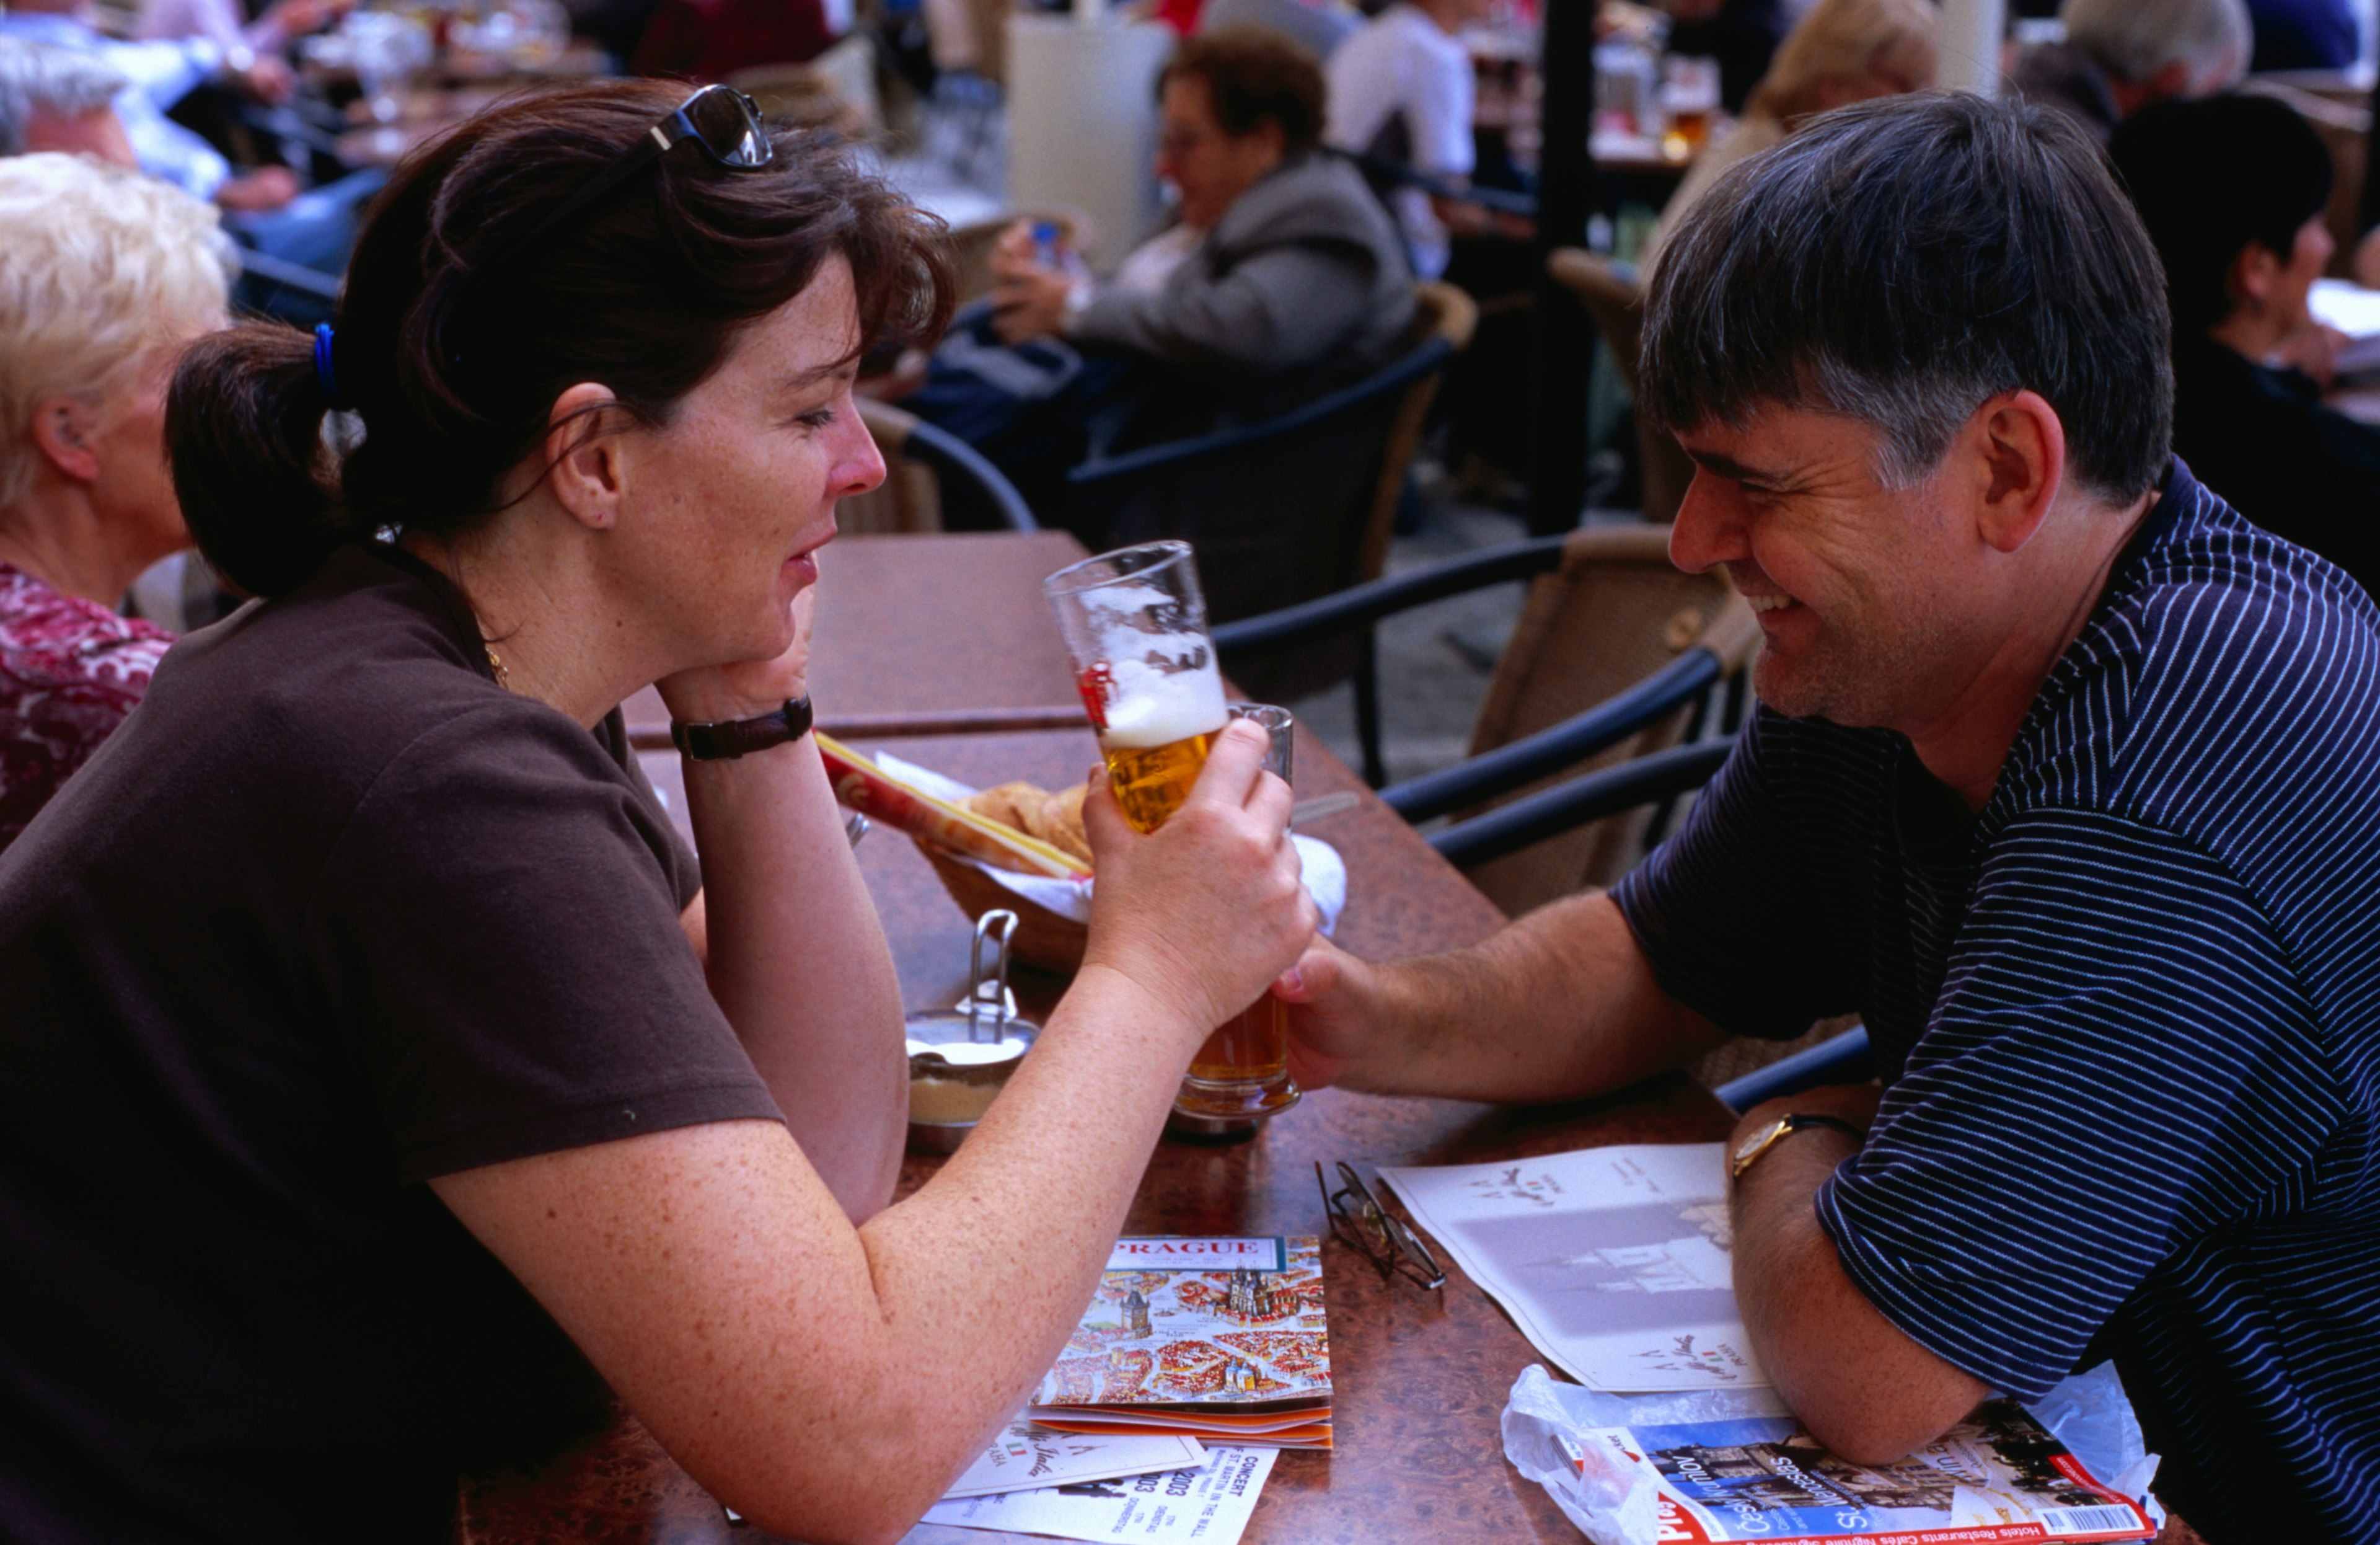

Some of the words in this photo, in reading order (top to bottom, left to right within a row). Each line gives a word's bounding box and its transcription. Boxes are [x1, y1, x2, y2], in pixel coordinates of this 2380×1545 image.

[989, 1441, 1007, 1467] RAHA
[1134, 1473, 1161, 1493] 003
[1165, 1471, 1196, 1497] 2003
[1214, 1466, 1236, 1491] MARTIN
[1229, 1456, 1259, 1497] CONCERT
[1672, 1456, 1735, 1498] Krumlov
[1770, 1457, 1849, 1507] Wenceslas
[1209, 1493, 1223, 1501] IN
[1111, 1497, 1140, 1534] DONNERSTAG
[1202, 1503, 1218, 1516] THE
[1835, 1507, 1867, 1529] St.
[1190, 1518, 1210, 1538] WALL
[1921, 1529, 1998, 1543] Restaurants
[1999, 1526, 2040, 1538] Hotels
[1879, 1534, 1918, 1545] Cafés
